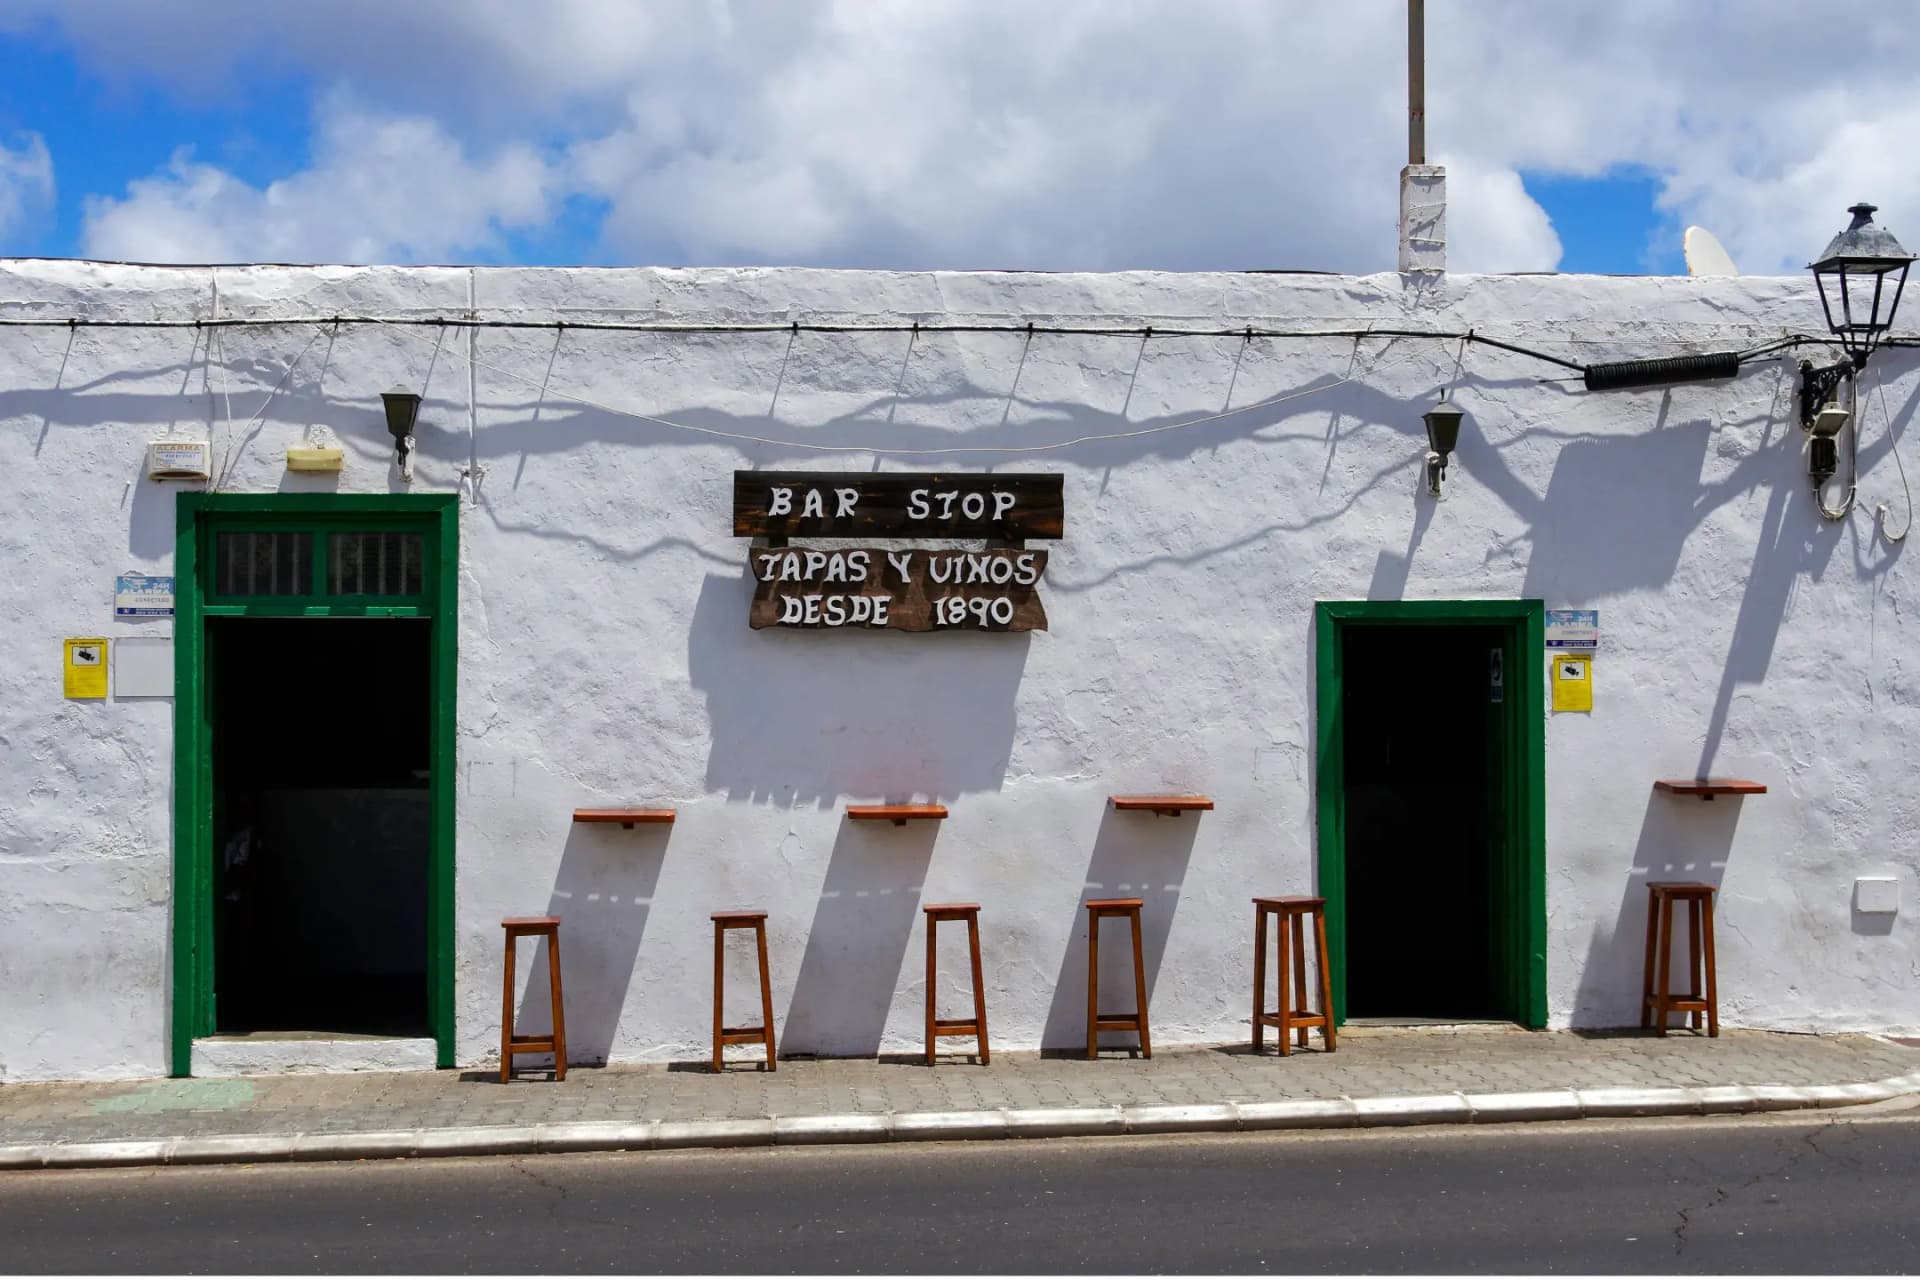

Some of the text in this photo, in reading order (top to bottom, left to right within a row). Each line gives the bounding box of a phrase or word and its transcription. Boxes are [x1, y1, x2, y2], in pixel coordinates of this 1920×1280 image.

[768, 487, 1016, 520] BAR STOP
[758, 551, 870, 582] TAPAS
[887, 553, 912, 583] Y
[122, 587, 170, 595] ALARMA
[777, 594, 1013, 628] DESDE 1890
